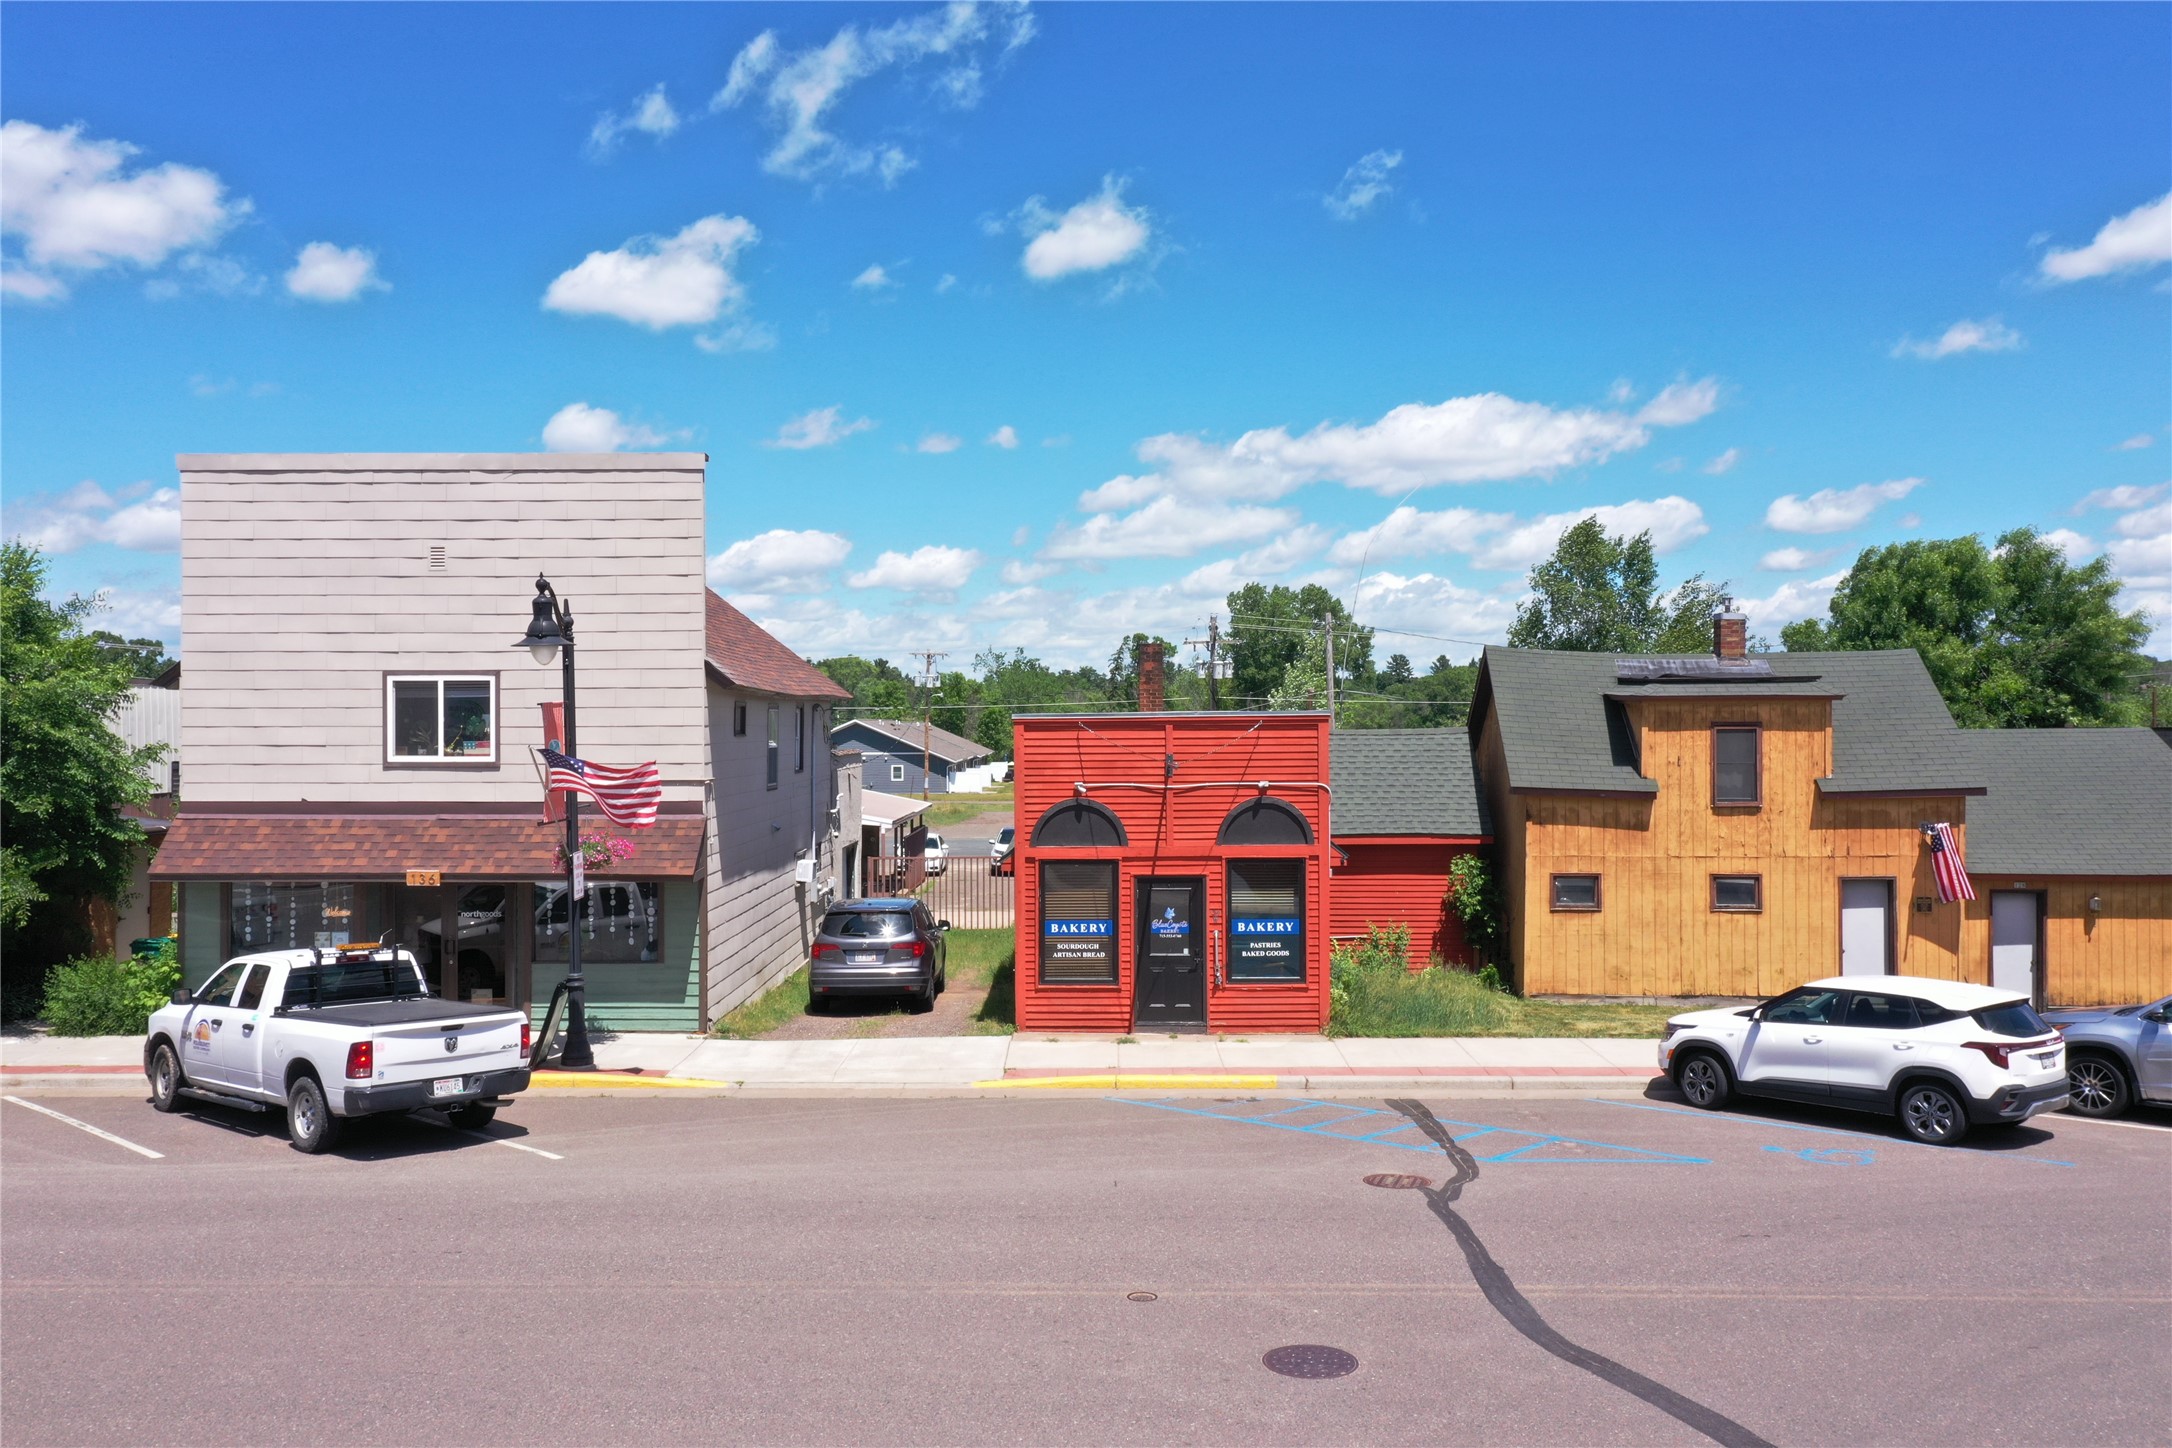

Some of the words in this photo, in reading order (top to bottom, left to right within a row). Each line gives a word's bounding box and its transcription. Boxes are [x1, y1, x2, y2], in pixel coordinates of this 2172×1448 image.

[411, 874, 436, 886] 136
[461, 910, 502, 920] northgoods
[1051, 923, 1107, 933] BAKERY
[1237, 922, 1294, 932] BAKERY
